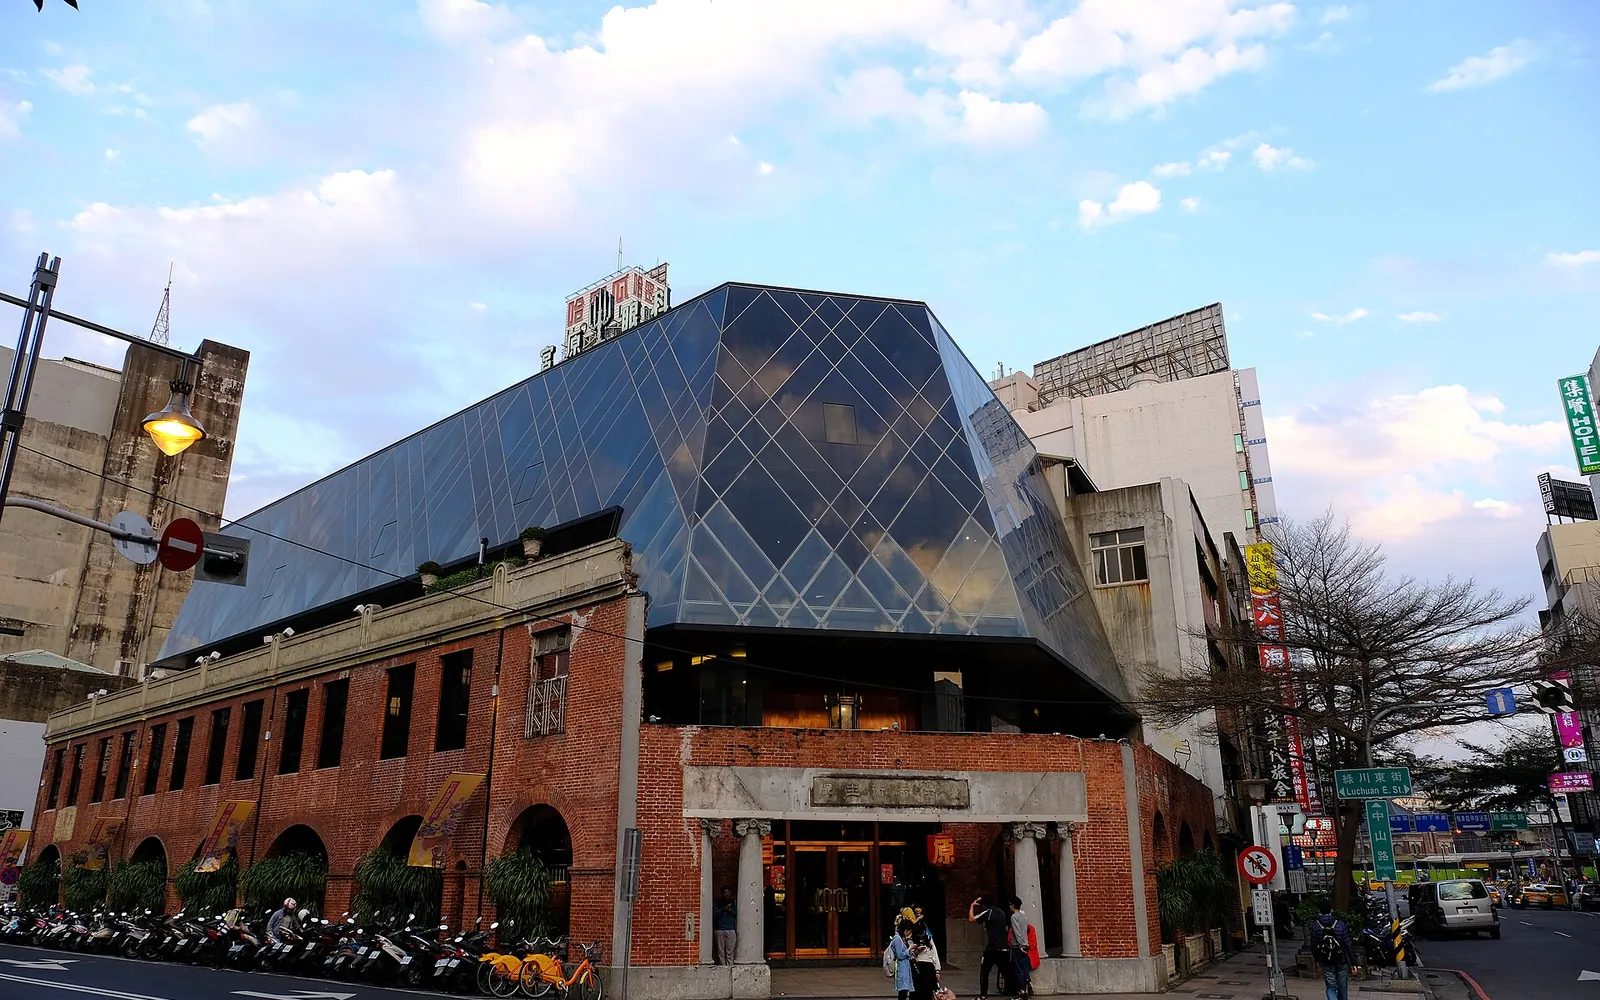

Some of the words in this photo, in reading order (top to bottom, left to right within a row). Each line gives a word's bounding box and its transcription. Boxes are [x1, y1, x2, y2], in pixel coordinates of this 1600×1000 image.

[1563, 379, 1587, 416] 集賢
[1571, 416, 1600, 466] HOTEL
[1342, 771, 1402, 785] 綠川東街
[1346, 786, 1380, 796] Luchuan
[1382, 786, 1391, 795] E.
[1393, 785, 1404, 794] St.
[932, 837, 955, 864] 原
[1372, 810, 1389, 861] 中山路
